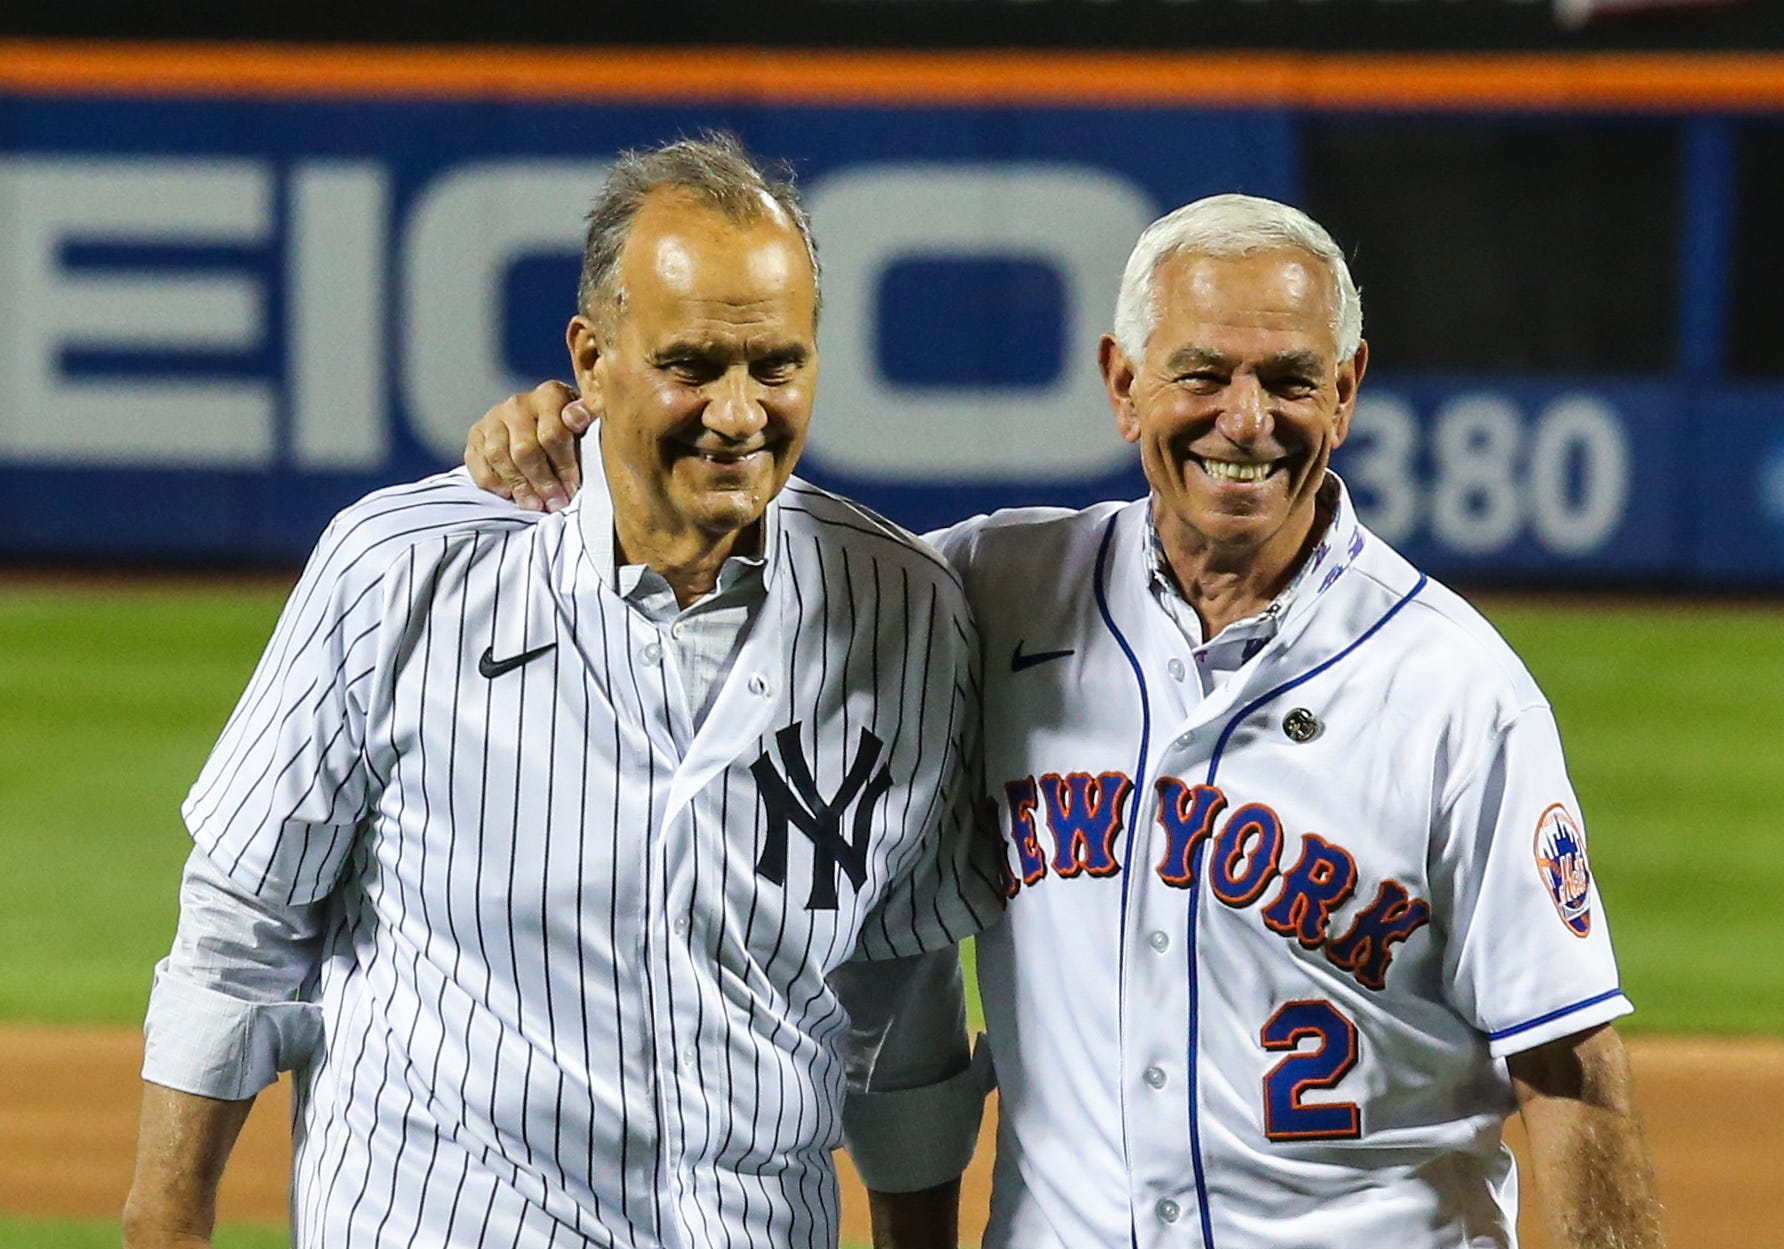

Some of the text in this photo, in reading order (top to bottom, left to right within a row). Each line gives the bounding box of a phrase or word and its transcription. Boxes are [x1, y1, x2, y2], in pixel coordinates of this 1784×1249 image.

[1346, 391, 1630, 556] 380
[750, 721, 894, 910] NY
[1155, 777, 1430, 990] YORK
[1261, 999, 1361, 1142] 2
